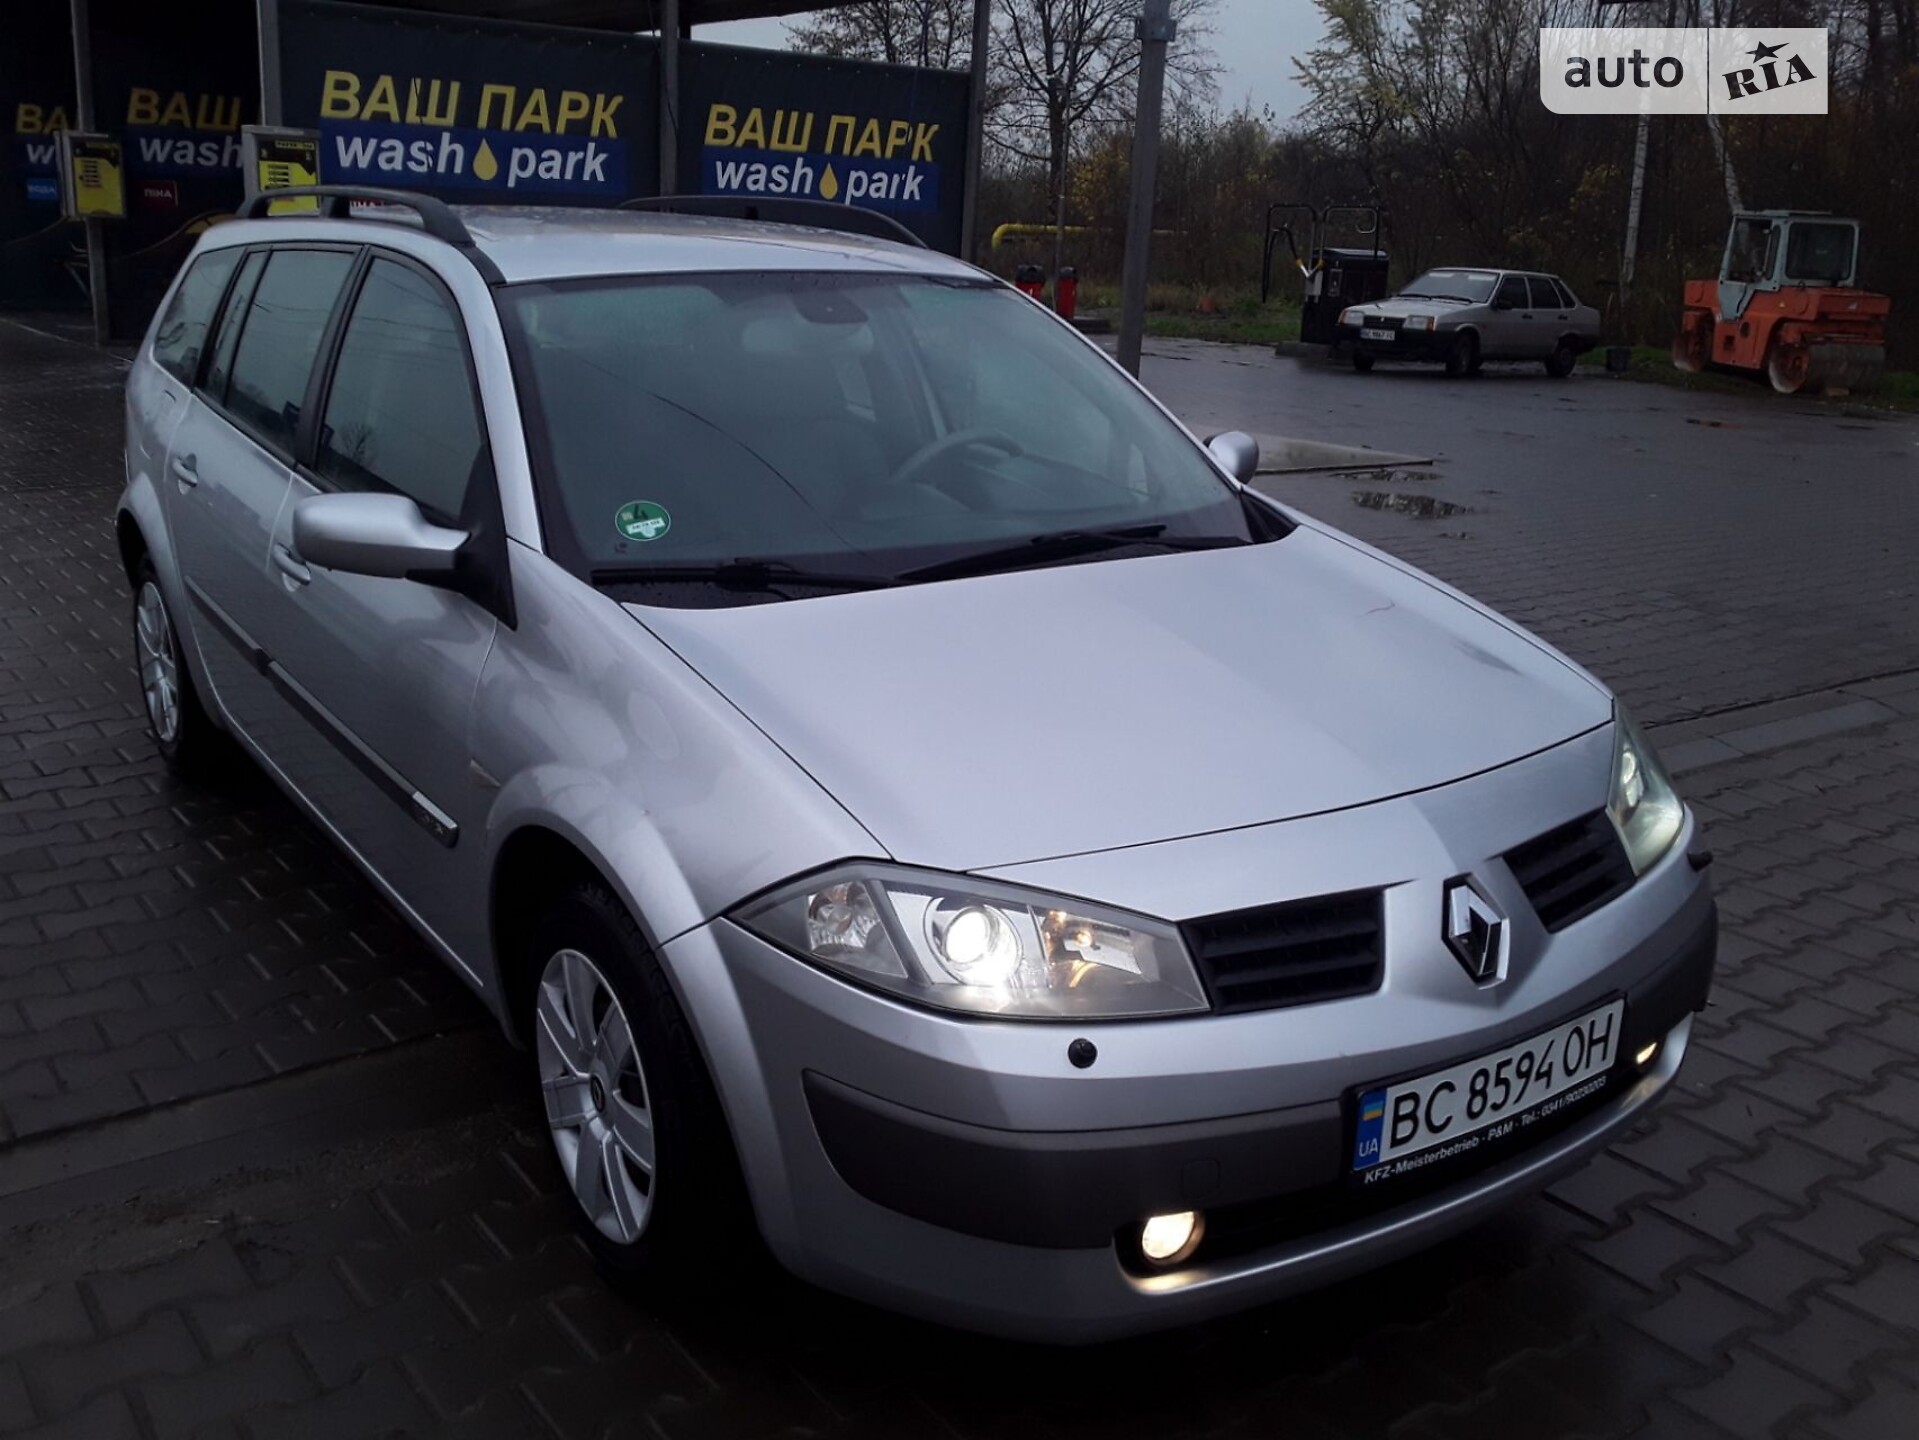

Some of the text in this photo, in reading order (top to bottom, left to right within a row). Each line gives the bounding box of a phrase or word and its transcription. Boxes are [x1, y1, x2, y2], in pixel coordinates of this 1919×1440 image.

[14, 102, 70, 134] ВА
[126, 86, 242, 132] ВАШ
[320, 70, 624, 139] ВАШ ПАРК
[139, 135, 243, 168] wash
[704, 104, 940, 162] ВАШ ПАРК
[335, 132, 609, 188] wash park
[715, 156, 923, 205] wash park
[1390, 1013, 1614, 1149] BC 8594 OH
[1358, 1136, 1380, 1158] UA
[1364, 1136, 1480, 1184] KFZ-Meisterbetrieb
